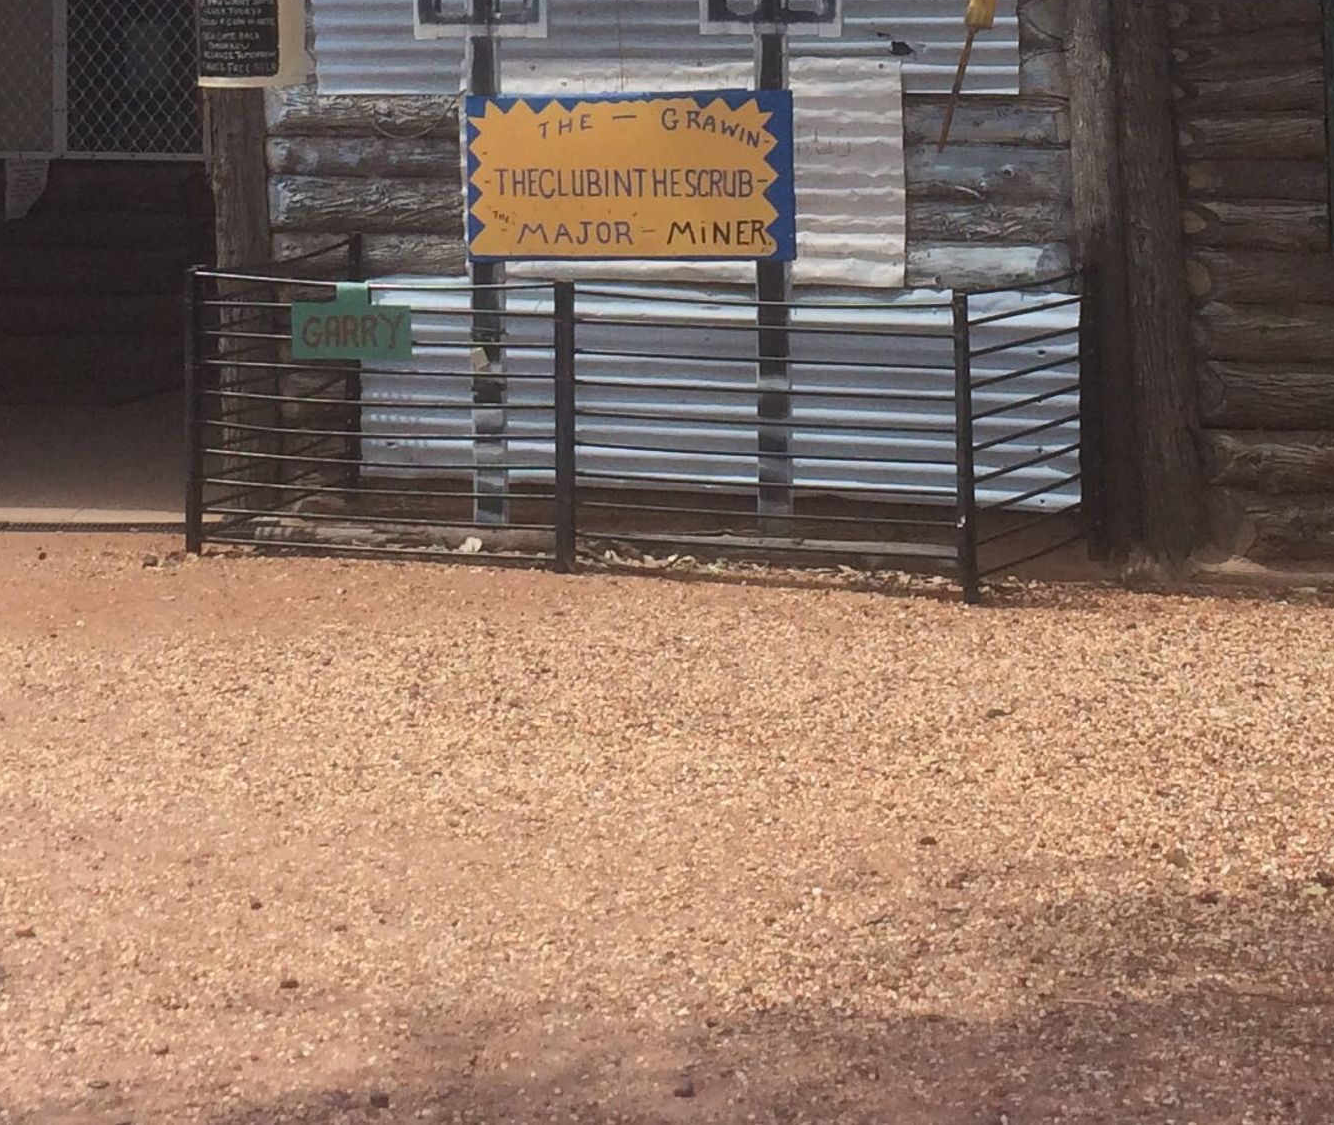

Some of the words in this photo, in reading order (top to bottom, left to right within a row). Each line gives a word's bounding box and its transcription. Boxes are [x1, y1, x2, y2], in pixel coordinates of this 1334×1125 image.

[538, 114, 593, 139] THE
[661, 107, 760, 148] GRAWIN
[517, 221, 634, 246] MAJOR
[301, 312, 406, 349] GARRY
